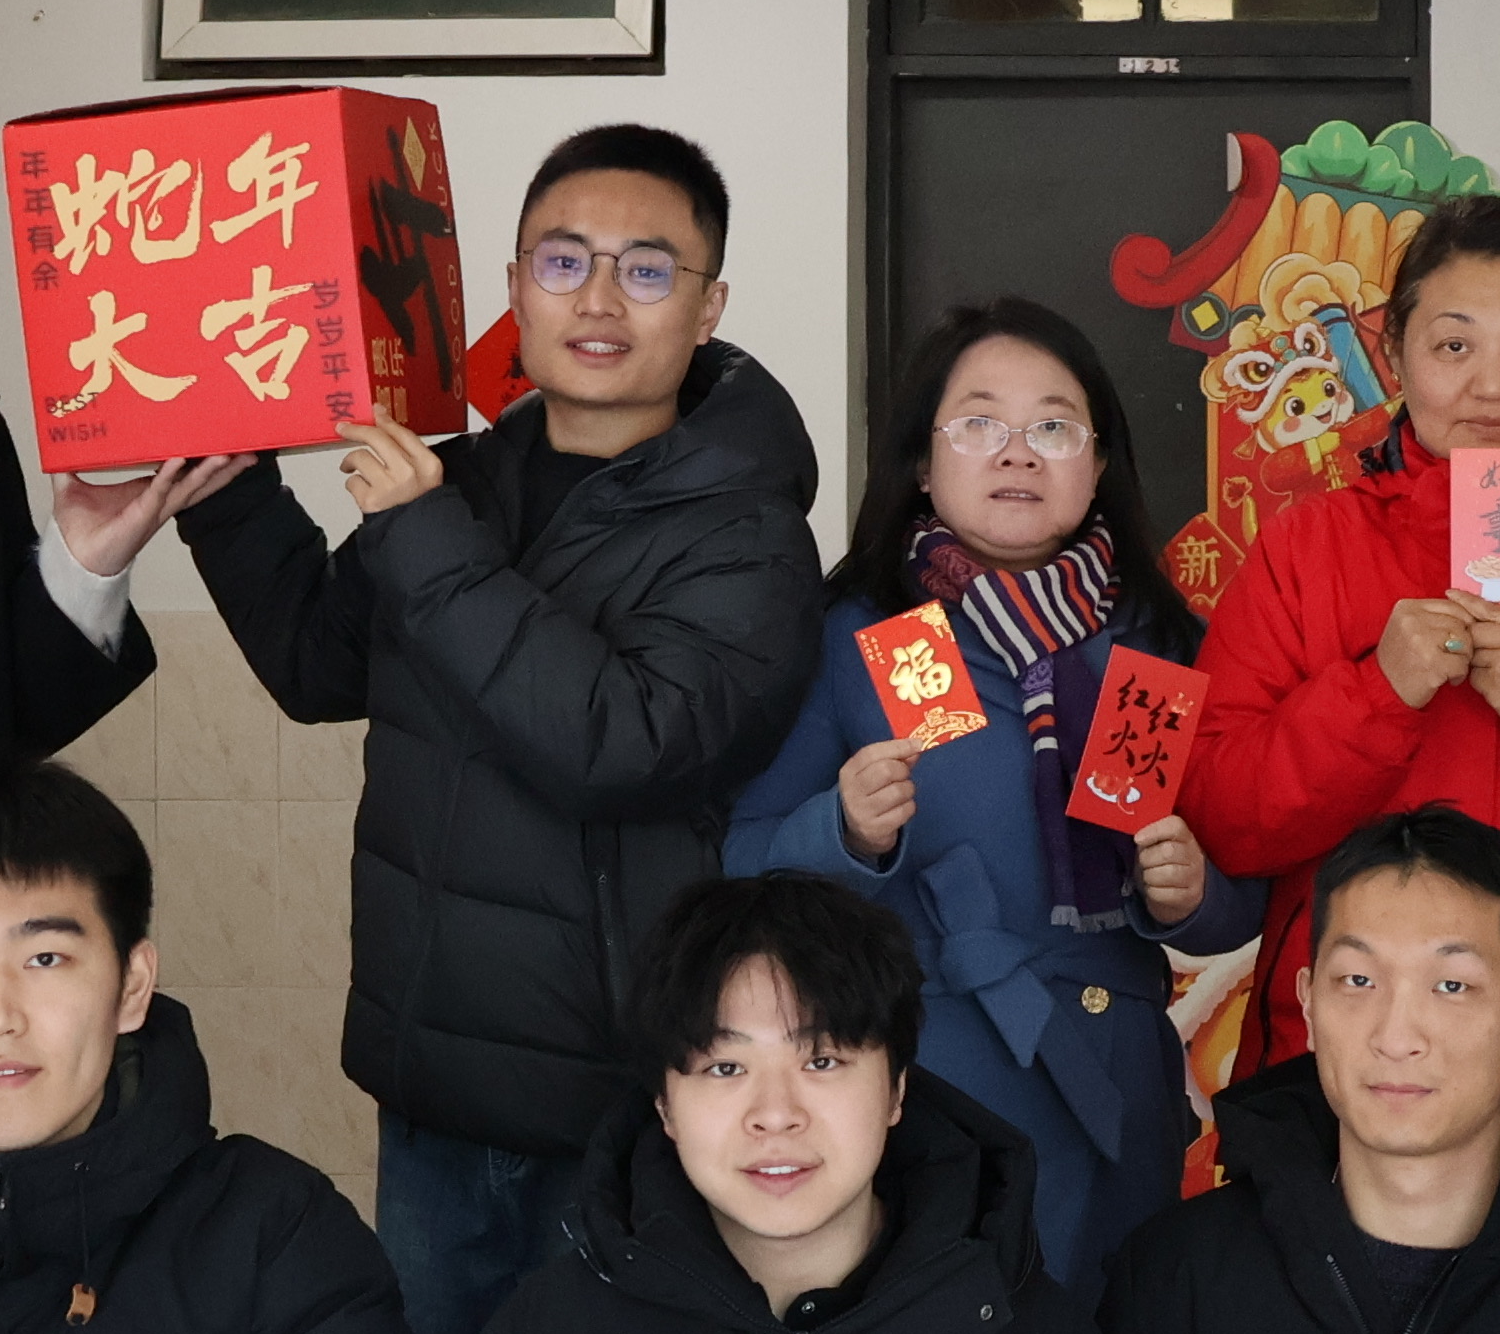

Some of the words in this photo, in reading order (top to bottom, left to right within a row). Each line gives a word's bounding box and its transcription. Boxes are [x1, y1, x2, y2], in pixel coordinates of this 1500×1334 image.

[20, 150, 60, 292] 年年有余
[50, 131, 320, 275] 蛇年
[50, 264, 315, 417] 大吉
[47, 424, 108, 444] WISH
[1176, 535, 1221, 589] 新
[889, 638, 953, 705] 福
